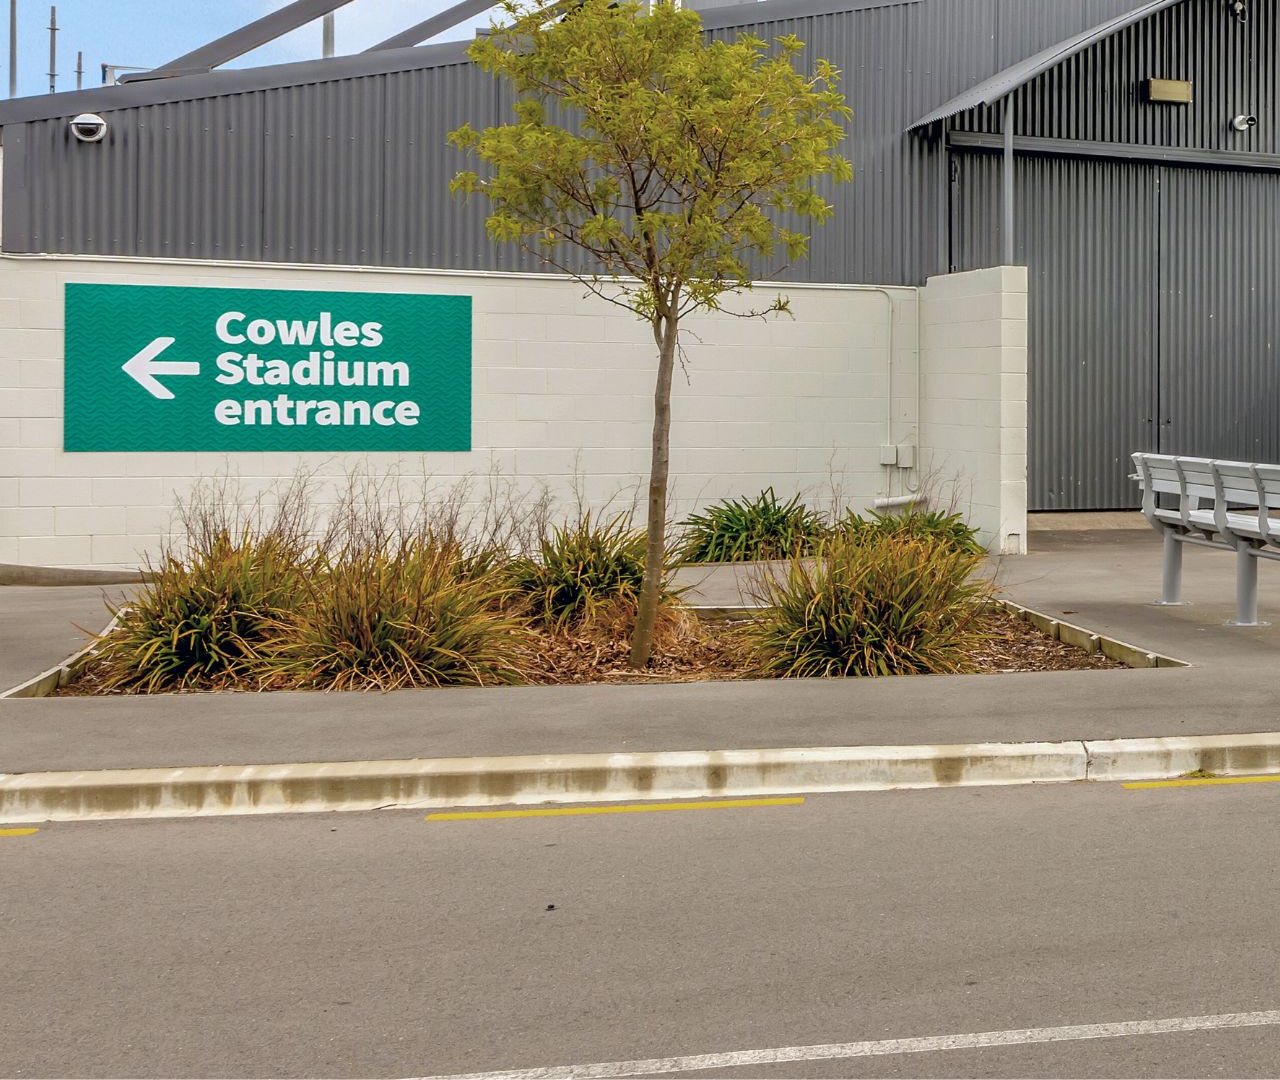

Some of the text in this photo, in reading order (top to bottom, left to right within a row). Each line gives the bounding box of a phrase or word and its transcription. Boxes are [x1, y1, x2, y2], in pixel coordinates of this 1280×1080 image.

[215, 311, 383, 347] Cowles
[215, 351, 409, 386] Stadium
[214, 394, 420, 426] entrance
